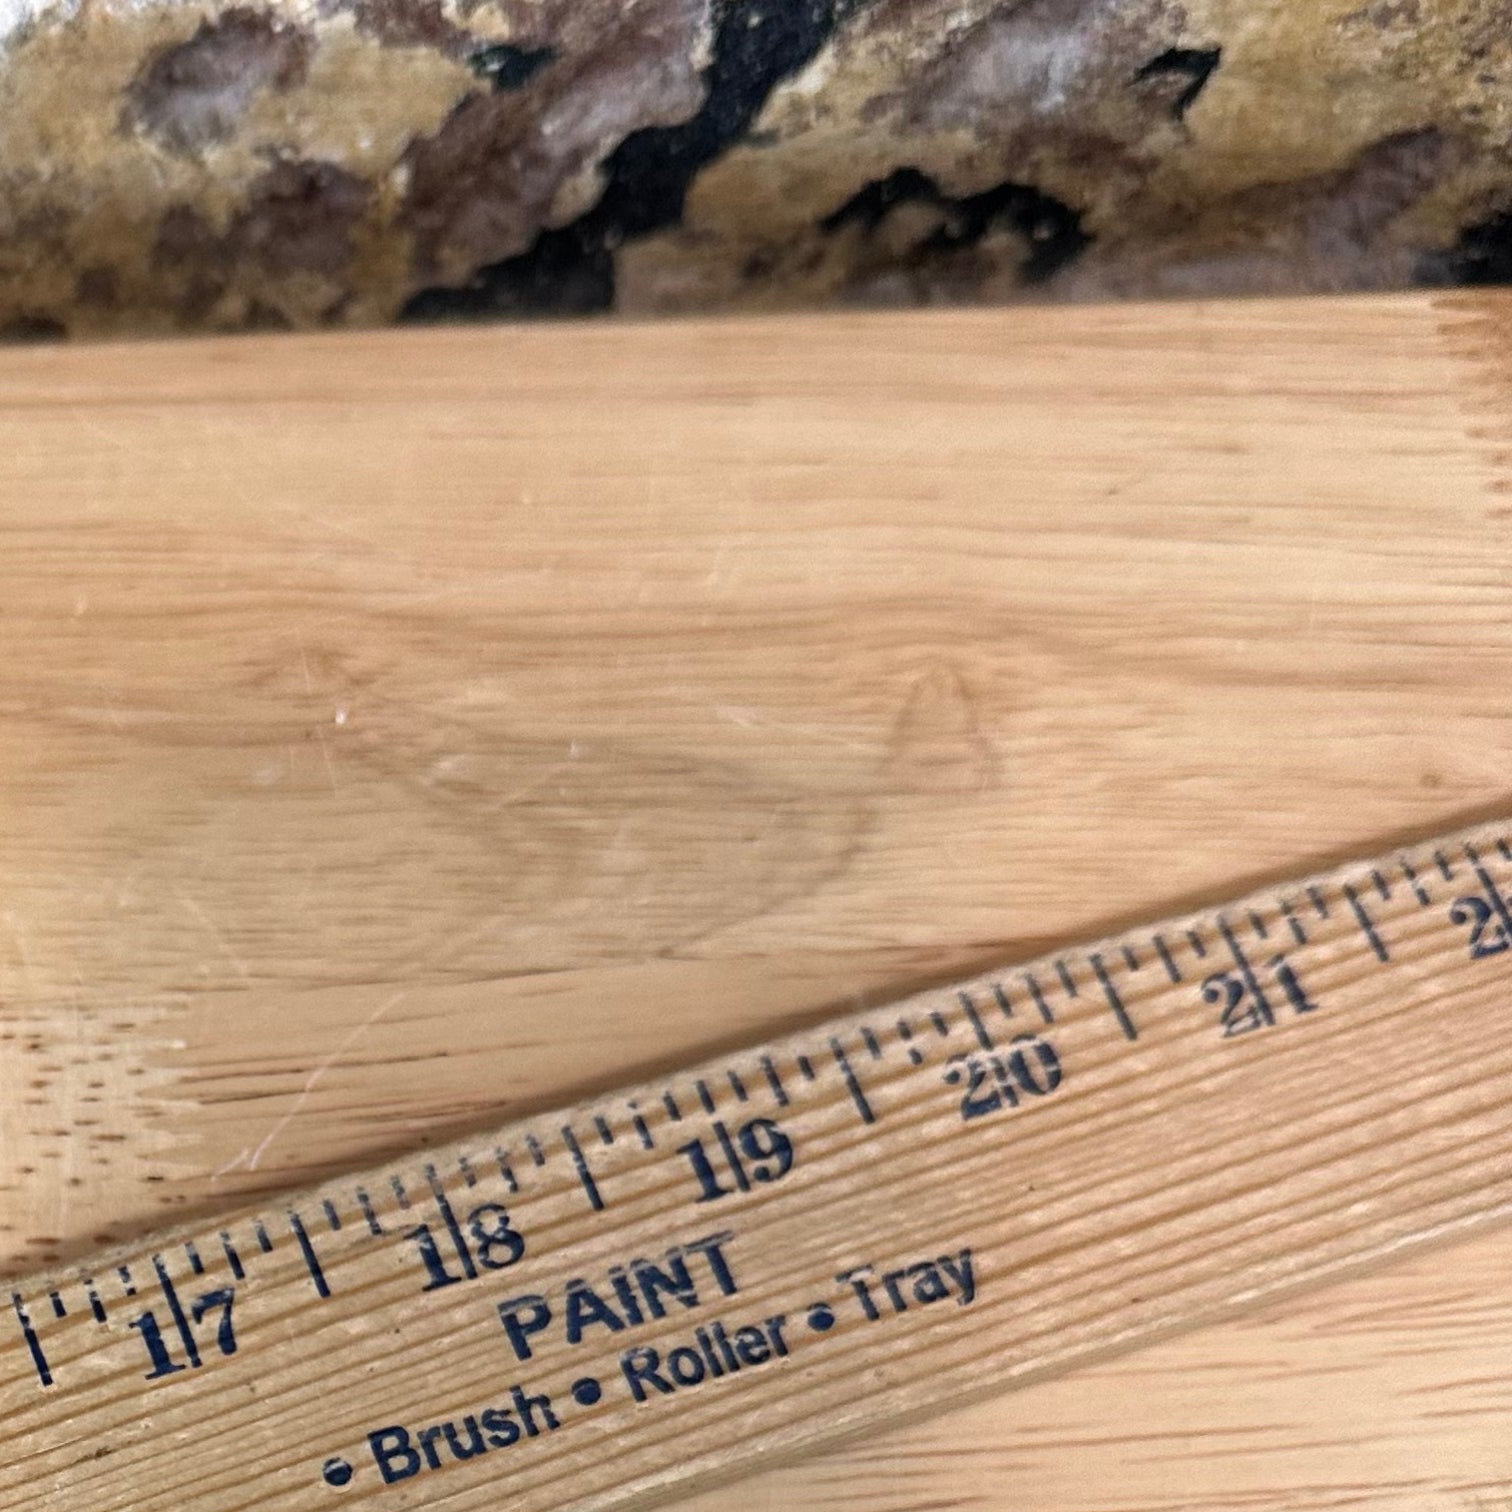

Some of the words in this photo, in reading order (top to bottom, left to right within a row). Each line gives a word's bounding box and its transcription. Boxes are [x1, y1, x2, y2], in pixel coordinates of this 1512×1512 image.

[129, 1287, 237, 1380] 17
[405, 1202, 526, 1291] 18
[676, 1117, 793, 1203] 19
[942, 1034, 1063, 1121] 20
[1200, 953, 1318, 1038] 21
[1449, 894, 1512, 960] 2
[367, 1385, 561, 1485] Brush
[620, 1315, 789, 1402] Roller
[836, 1248, 976, 1323] Tray
[498, 1229, 738, 1361] PAINT
